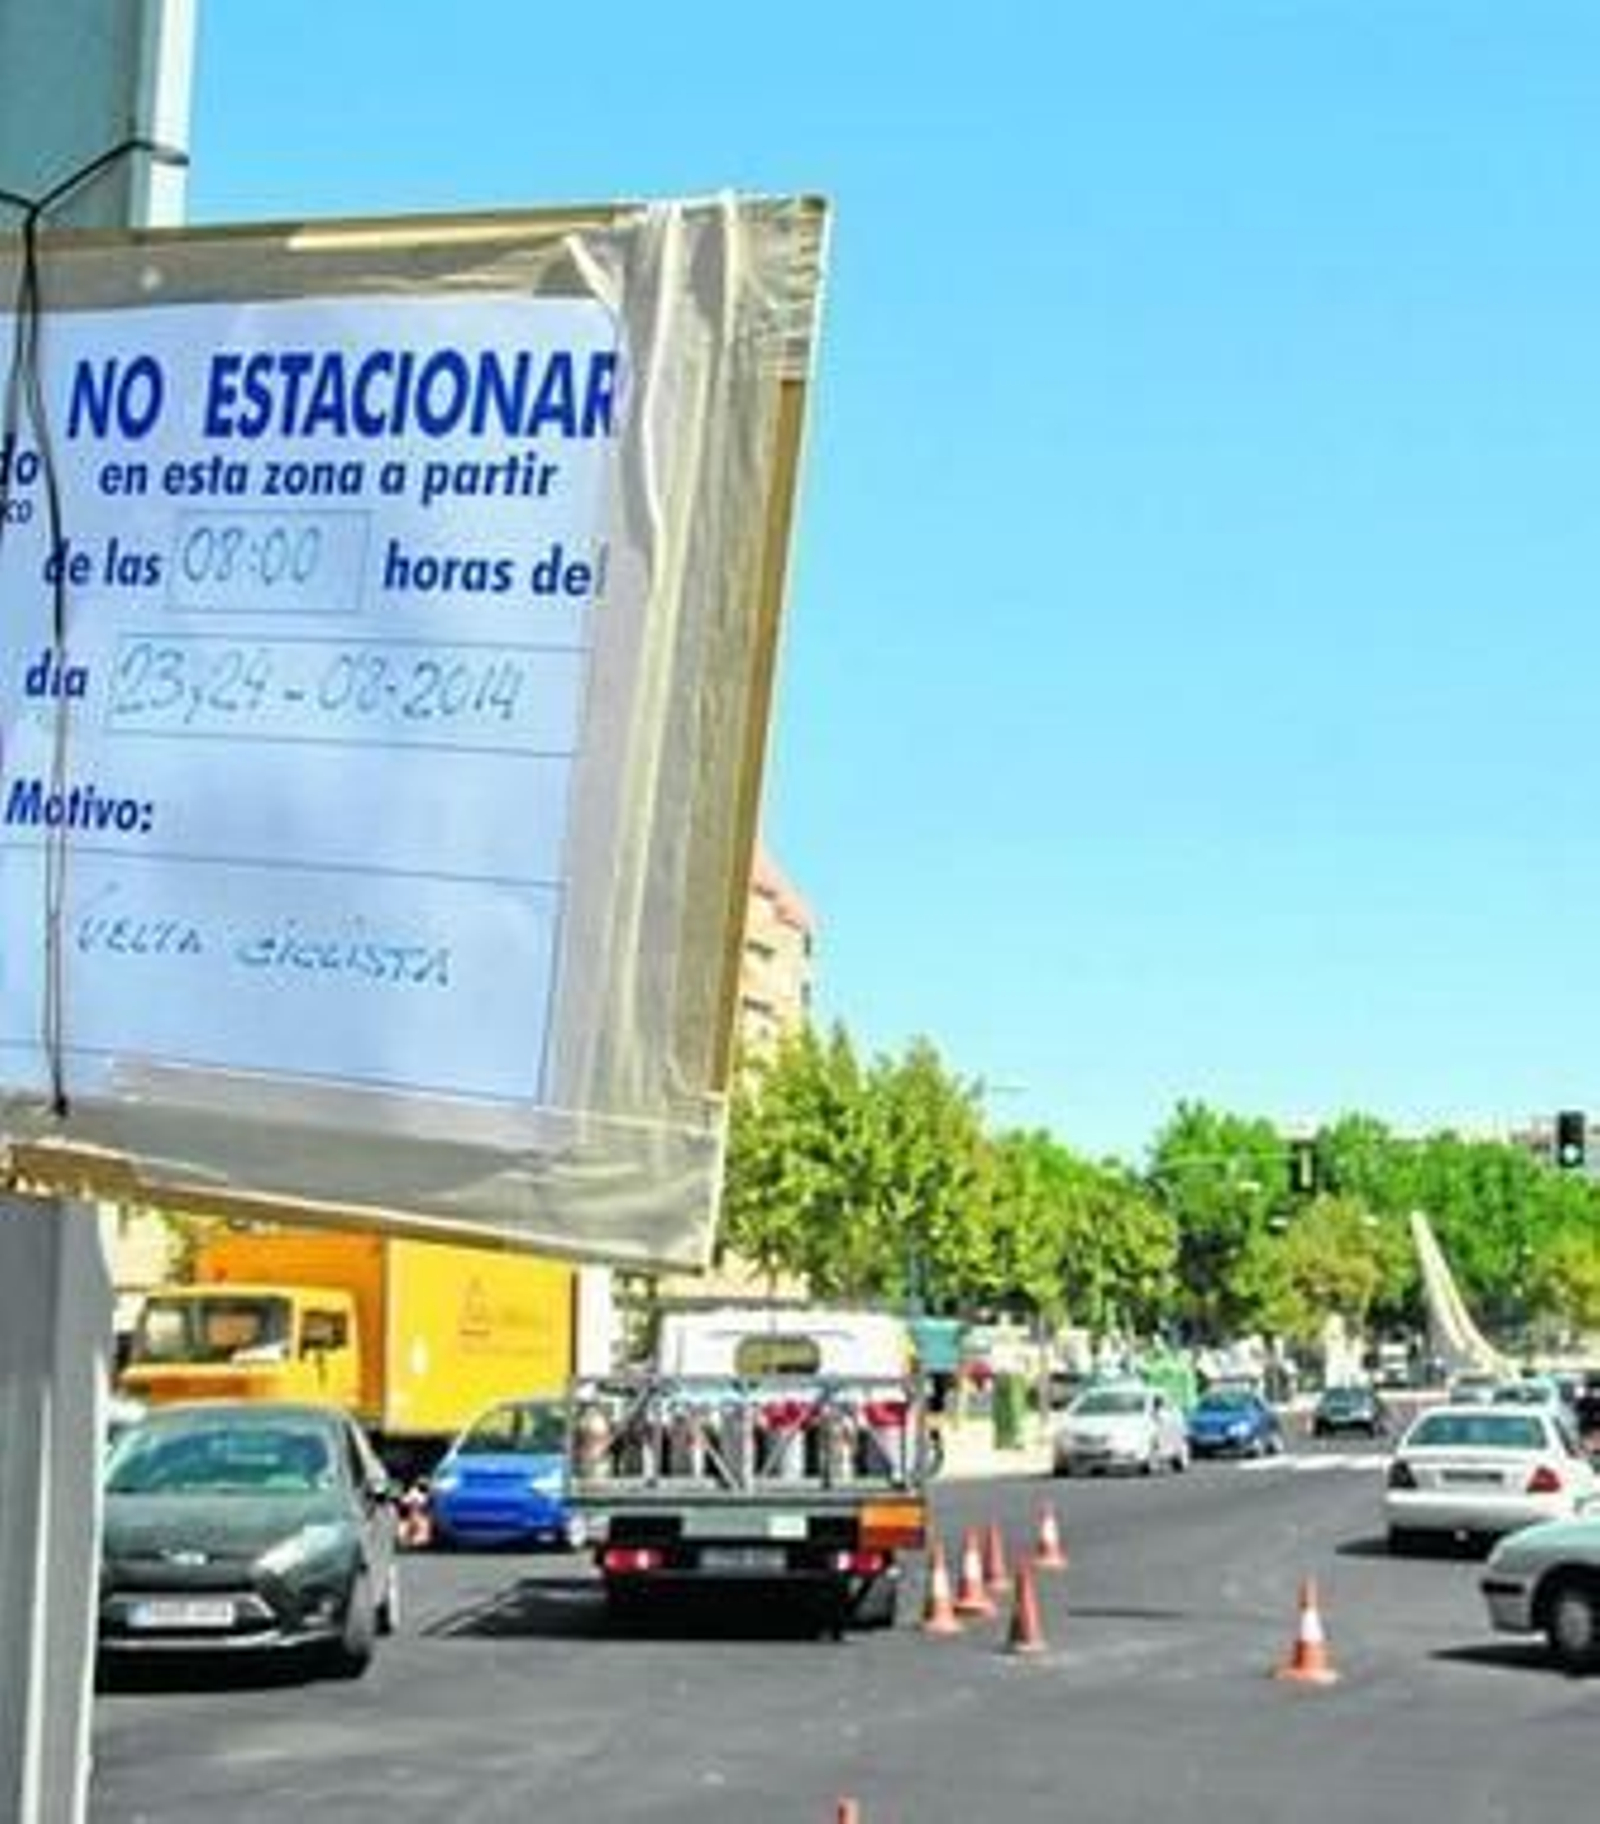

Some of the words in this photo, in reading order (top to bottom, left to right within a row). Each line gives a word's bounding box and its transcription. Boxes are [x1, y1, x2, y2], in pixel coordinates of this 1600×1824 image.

[66, 355, 163, 440] NO
[202, 350, 618, 438] ESTACIONAR
[100, 463, 148, 495] en
[163, 456, 248, 496] esta
[261, 464, 364, 496] zona
[379, 465, 407, 495] a
[421, 451, 559, 505] partir
[43, 538, 91, 586] de
[104, 538, 162, 586] las
[183, 526, 323, 586] 08:00
[384, 550, 514, 592] horas
[5, 779, 153, 833] Motivo:
